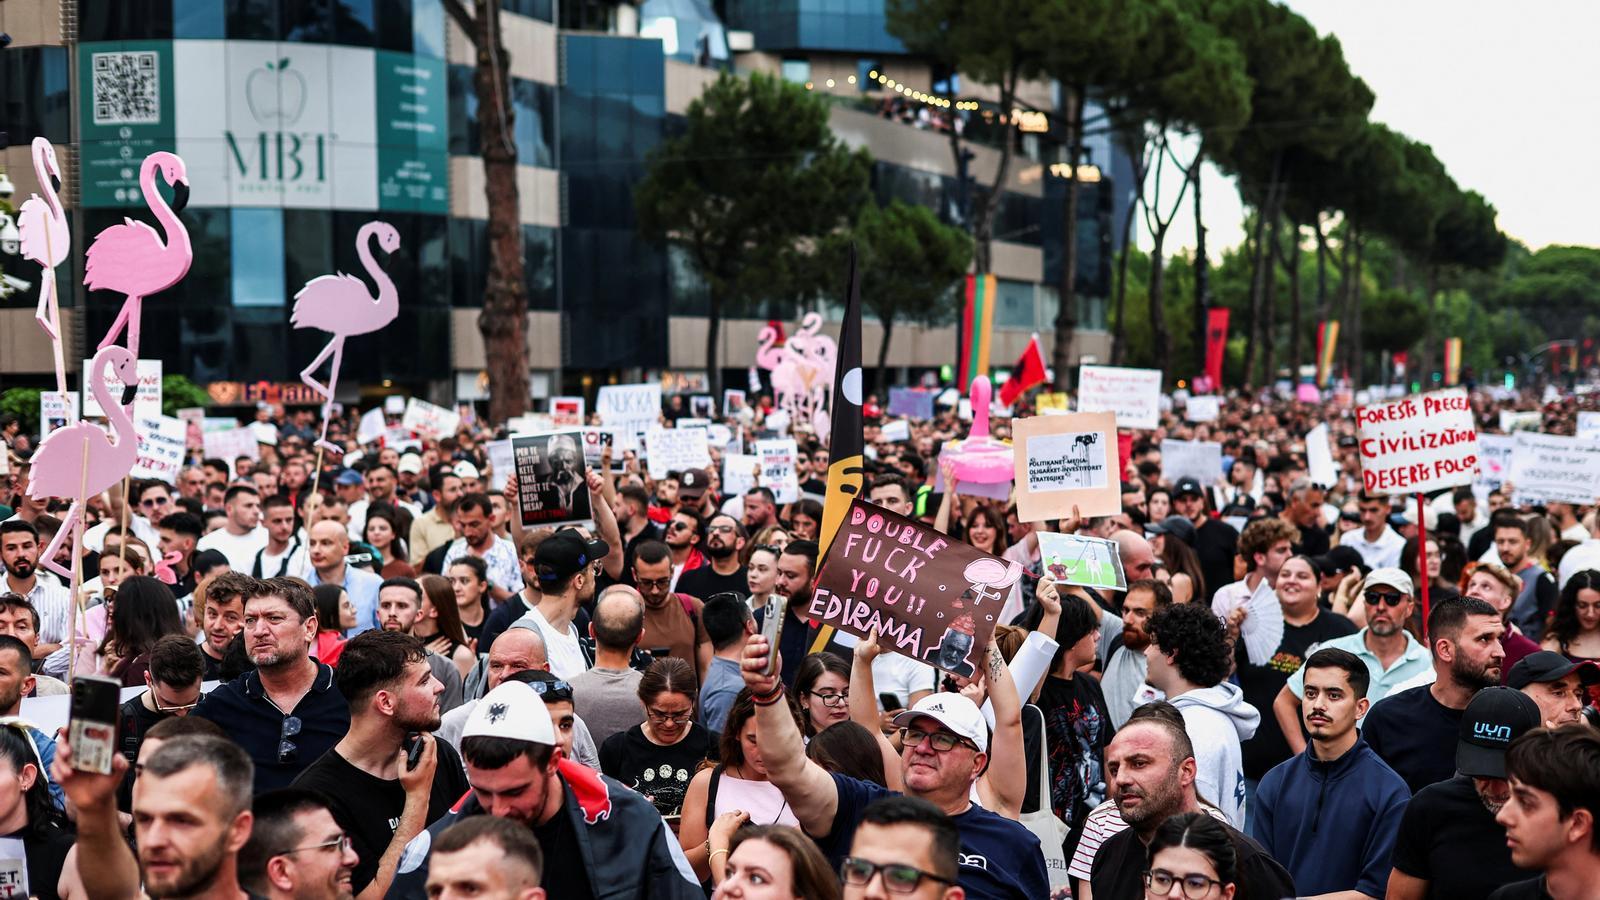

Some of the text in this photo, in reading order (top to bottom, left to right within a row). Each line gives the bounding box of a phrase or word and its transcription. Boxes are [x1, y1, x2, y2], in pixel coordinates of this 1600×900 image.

[223, 131, 338, 182] MBT
[1360, 428, 1476, 457] CIVILIZATION
[844, 533, 926, 584] FUCK
[851, 506, 949, 560] DOUBLE
